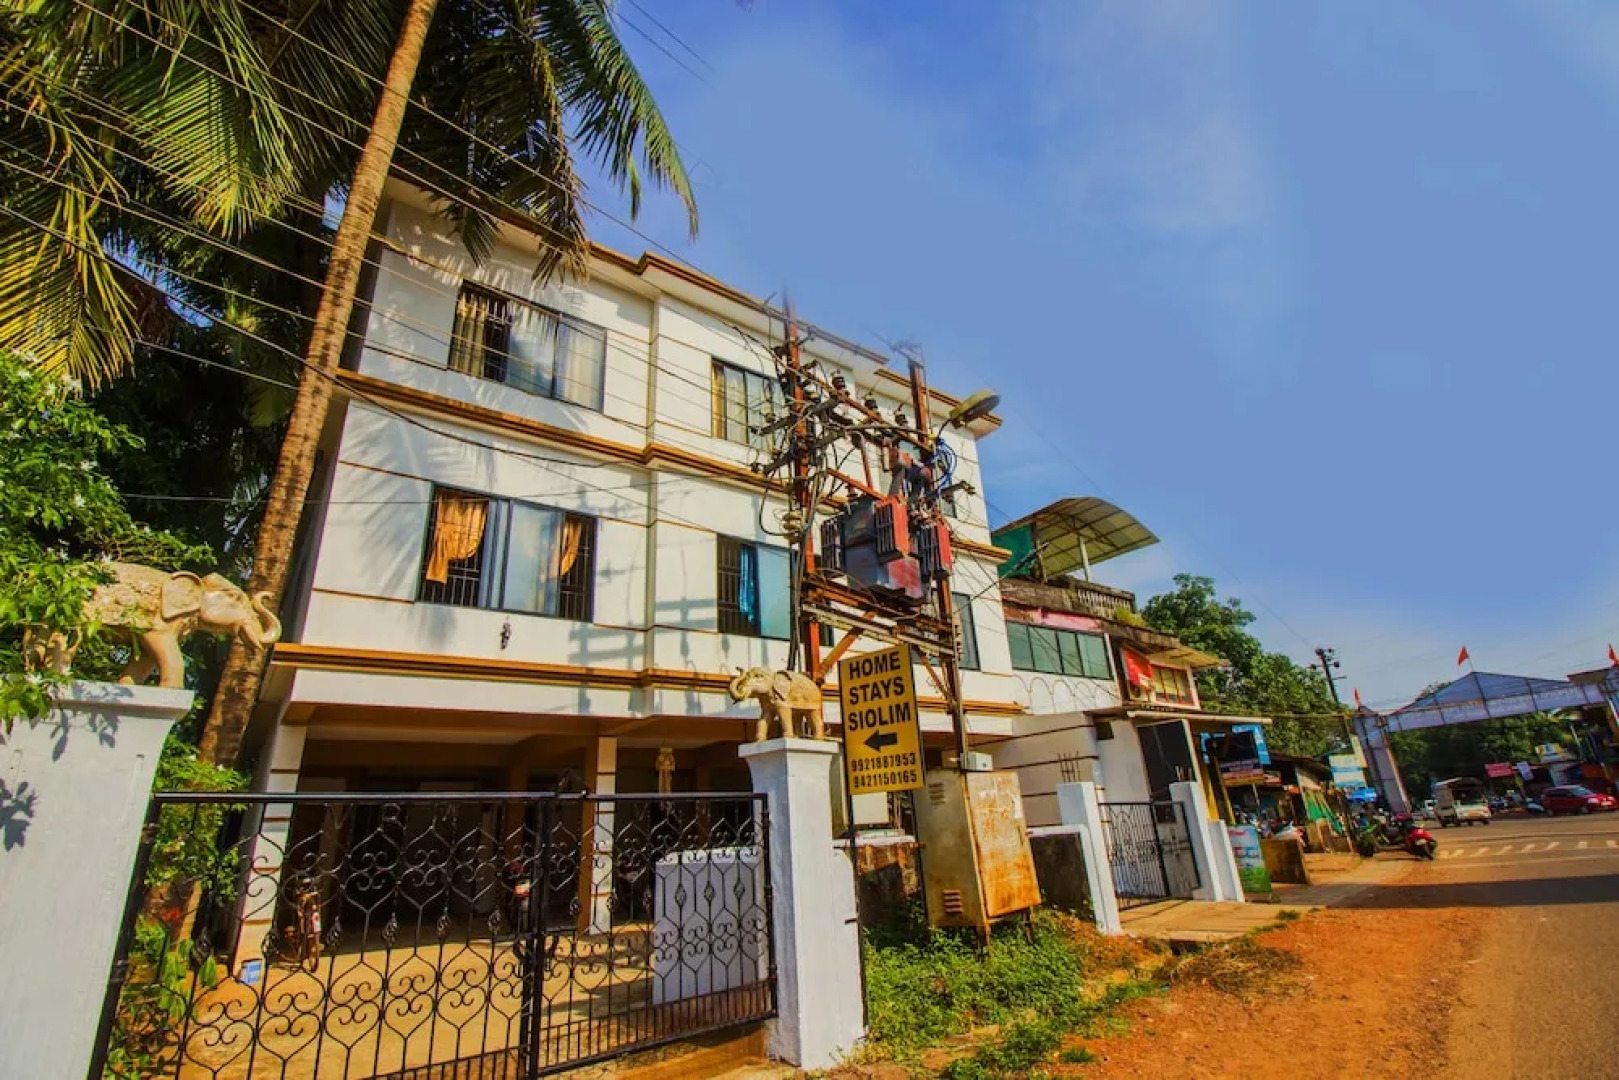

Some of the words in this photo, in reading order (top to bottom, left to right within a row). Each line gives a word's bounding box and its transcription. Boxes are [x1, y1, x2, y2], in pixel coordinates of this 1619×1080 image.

[849, 652, 900, 679] HOME
[849, 677, 904, 704] STAYS
[849, 703, 911, 730] SIOLIM
